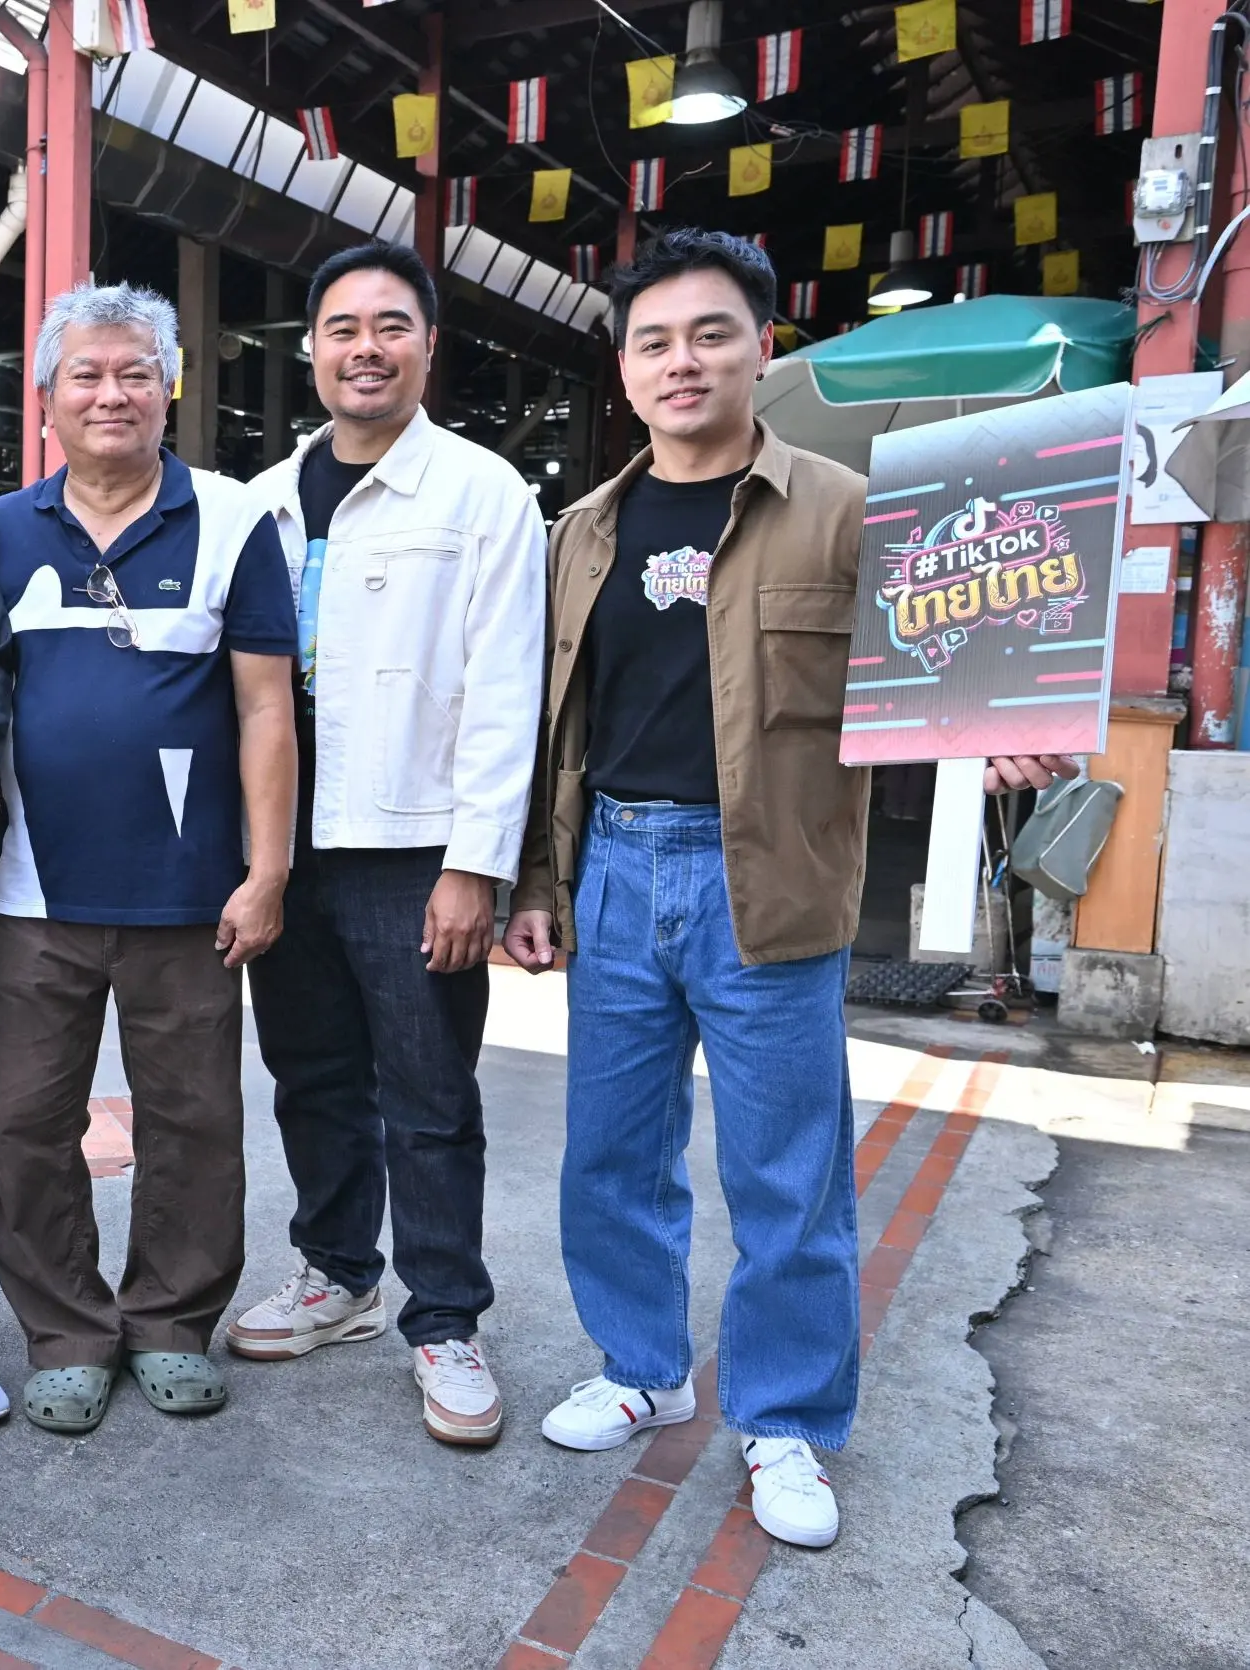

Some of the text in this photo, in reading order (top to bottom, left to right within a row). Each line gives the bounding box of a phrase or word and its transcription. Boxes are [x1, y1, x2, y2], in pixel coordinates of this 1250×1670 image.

[660, 562, 707, 574] #TikTok
[914, 528, 1040, 578] #TikTok
[647, 572, 708, 594] ไทยไท
[882, 553, 1079, 637] ไทยไทย
